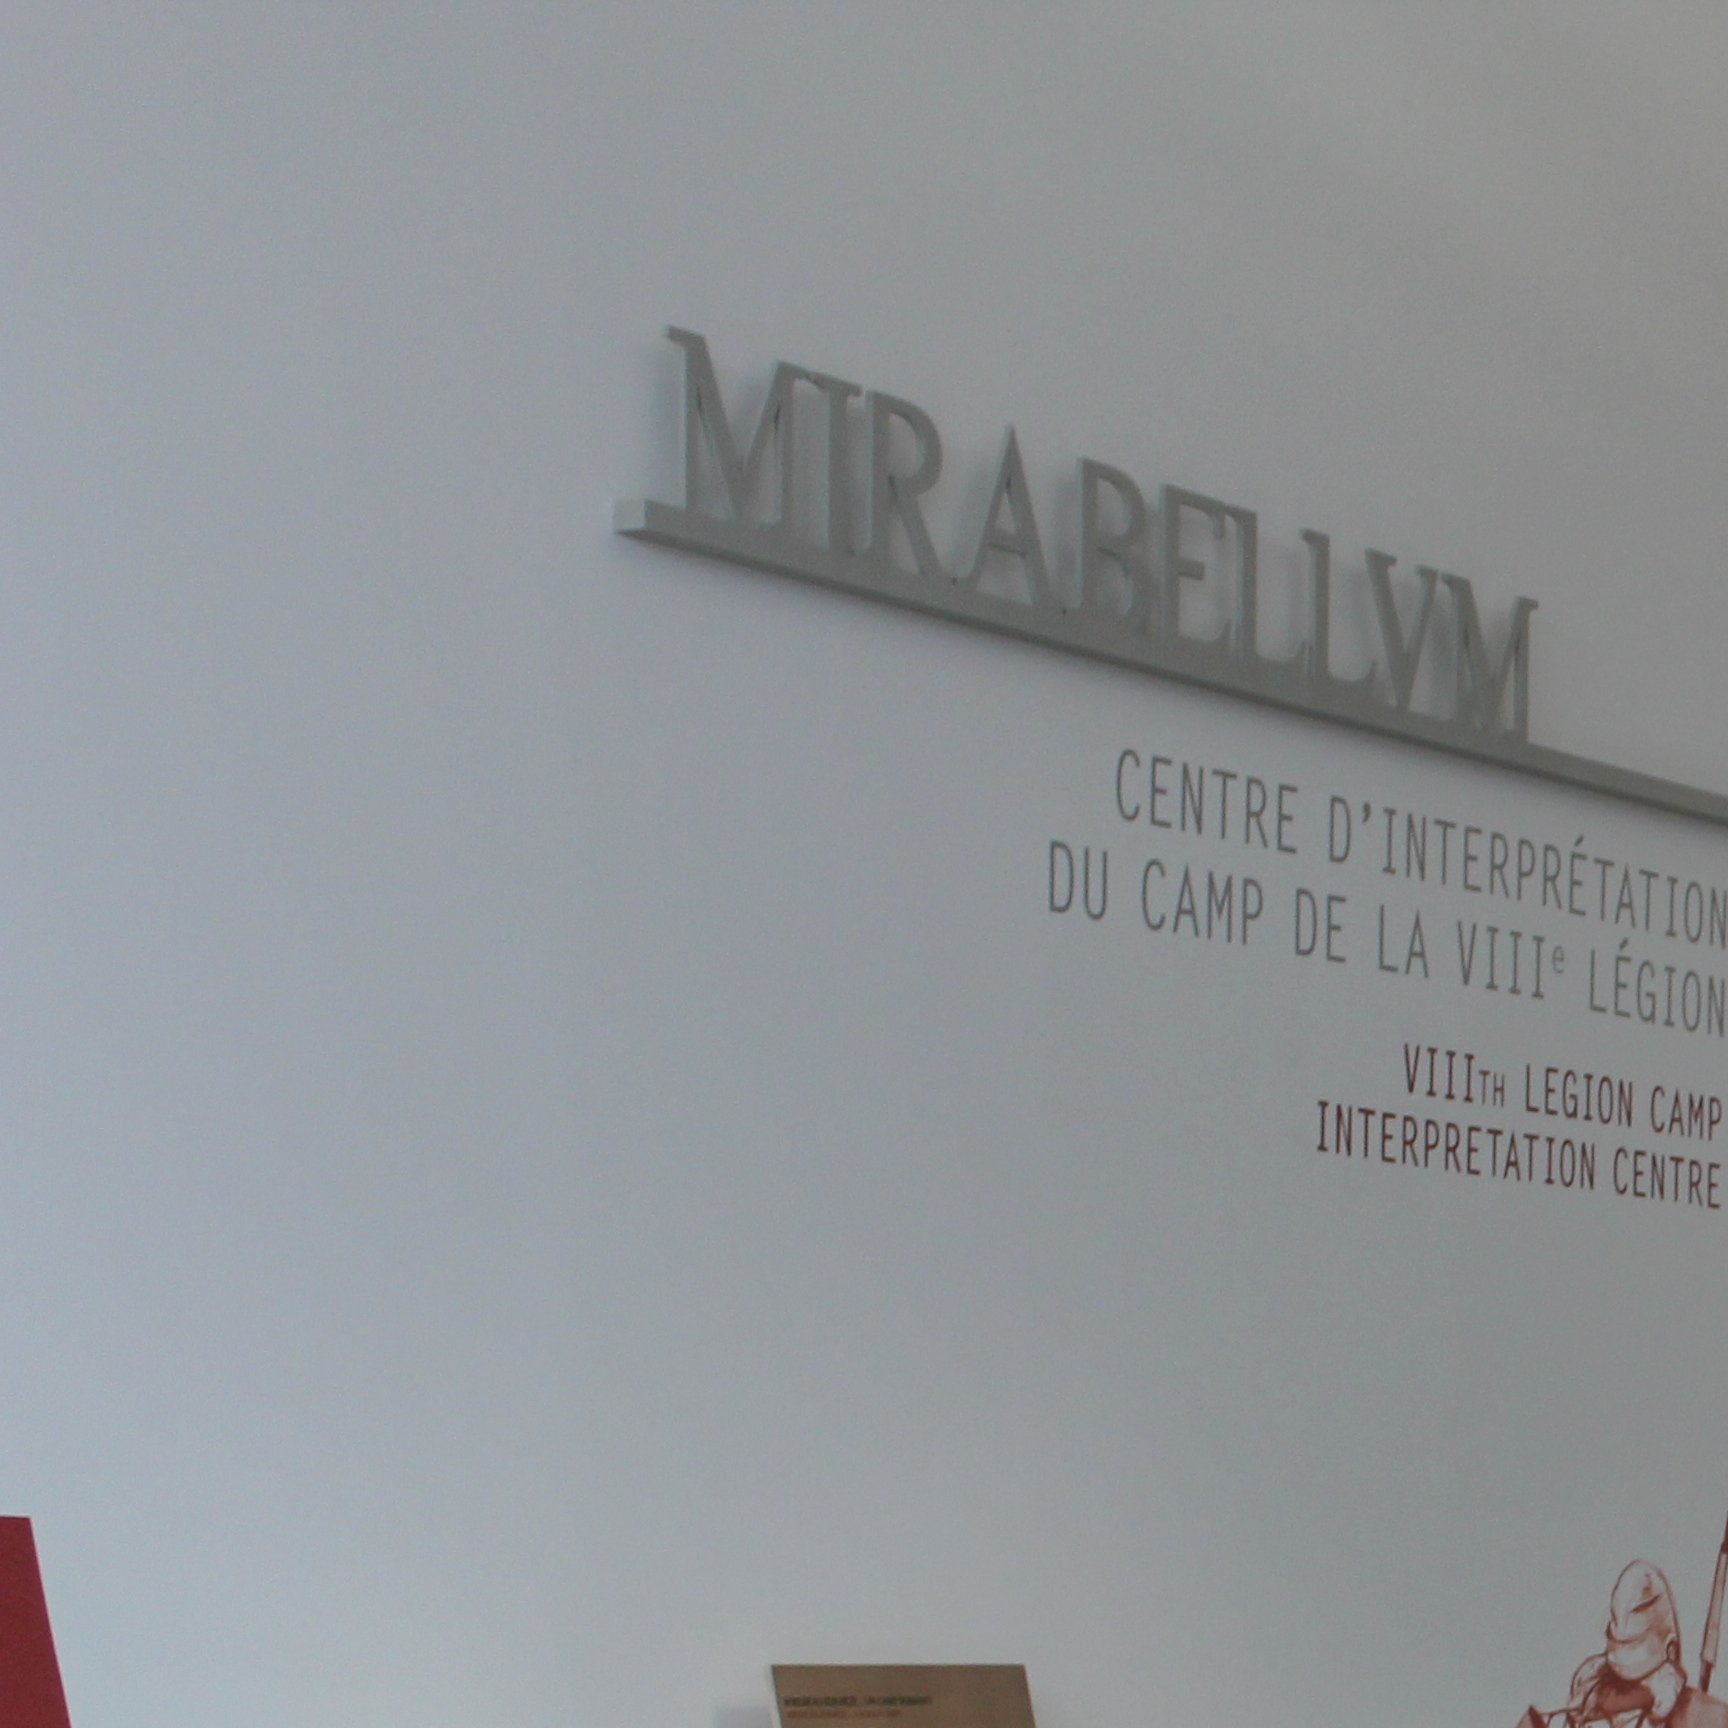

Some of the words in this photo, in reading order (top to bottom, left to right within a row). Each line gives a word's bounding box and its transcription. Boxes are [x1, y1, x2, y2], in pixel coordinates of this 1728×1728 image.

[666, 325, 1540, 745] MIRABELLVM
[1048, 839, 1108, 921] DU
[1142, 857, 1264, 946] CAMP
[1294, 887, 1347, 963] DE
[1378, 903, 1430, 979] LA
[1589, 936, 1725, 1038] LÉGION
[1116, 748, 1298, 855] CENTRE
[1328, 795, 1728, 950] D'INTERPRÉTATION
[1316, 1099, 1597, 1191] INTERPRETATION
[1612, 1145, 1722, 1211] CENTRE
[1524, 1062, 1634, 1128] LEGION
[1650, 1084, 1723, 1142] CAMP
